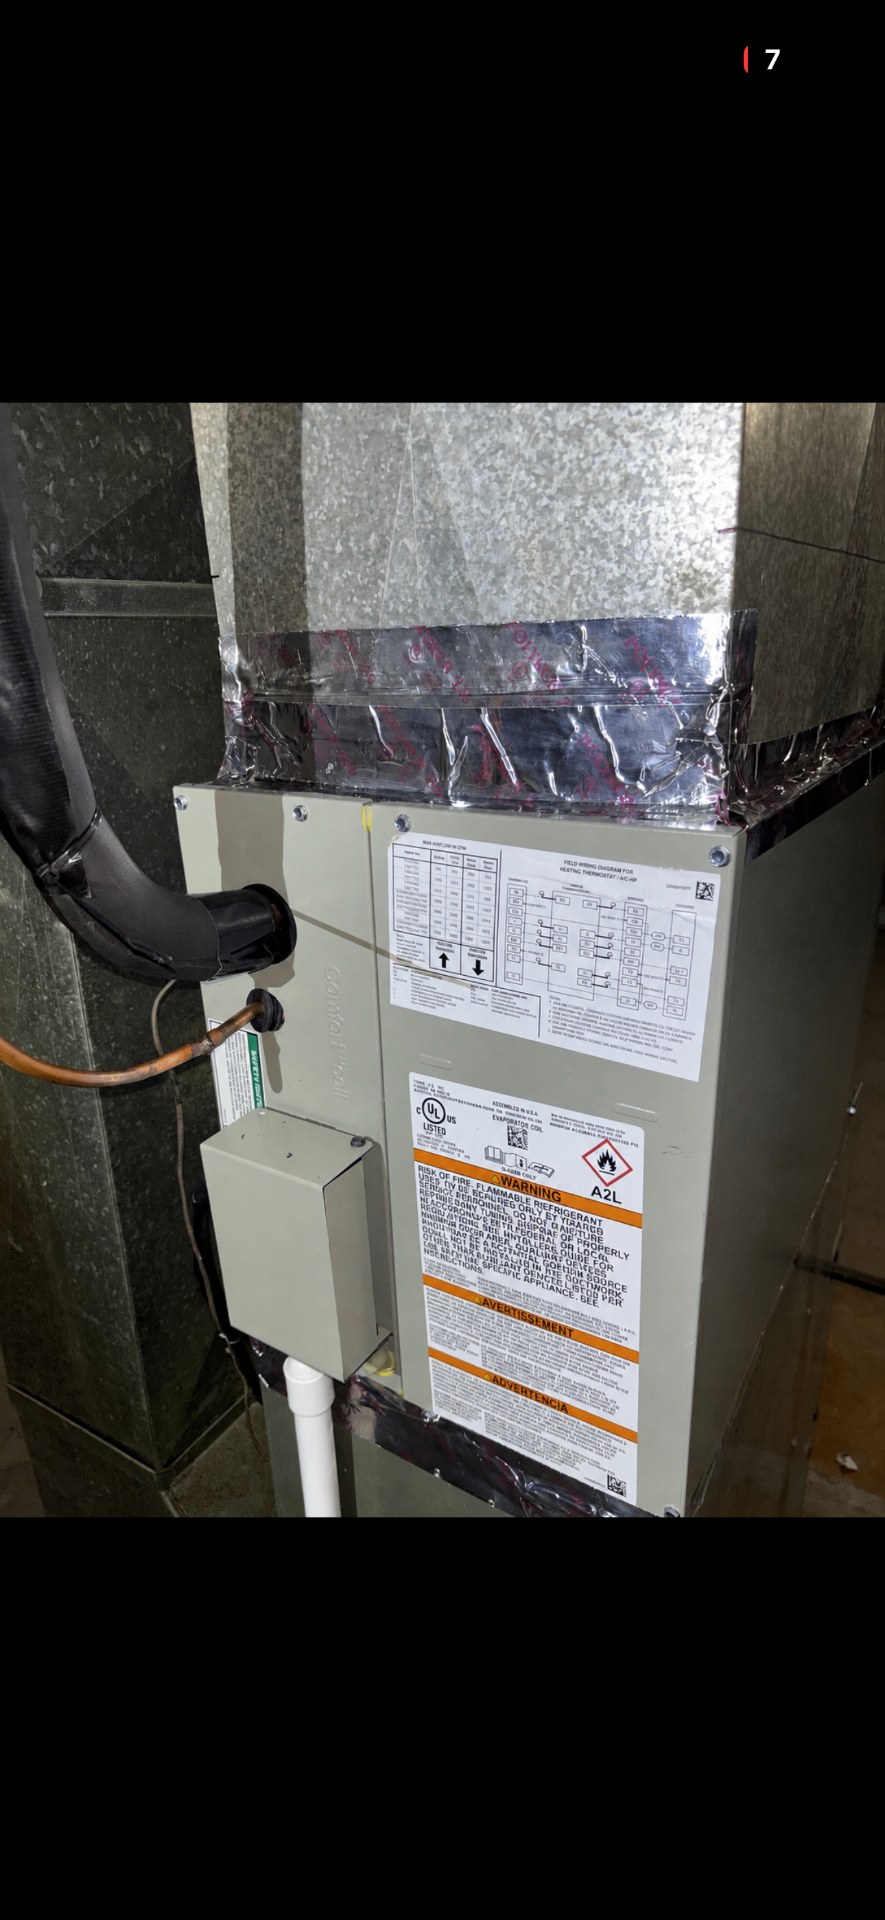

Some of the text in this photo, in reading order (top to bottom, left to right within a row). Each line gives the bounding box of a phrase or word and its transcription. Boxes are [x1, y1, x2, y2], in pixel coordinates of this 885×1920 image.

[426, 1101, 440, 1120] UL
[446, 1114, 456, 1124] US
[422, 1121, 446, 1136] LISTED
[417, 1164, 436, 1177] RISK
[438, 1170, 450, 1181] OF
[452, 1174, 473, 1188] FIRE.
[475, 1181, 531, 1206] FLAMMABLE
[500, 1175, 562, 1203] WARNING
[591, 1185, 622, 1205] A2L
[593, 1258, 614, 1273] FOR
[482, 1297, 575, 1339] AVERTISSEMENT
[492, 1375, 569, 1414] ADVERTENCIA
